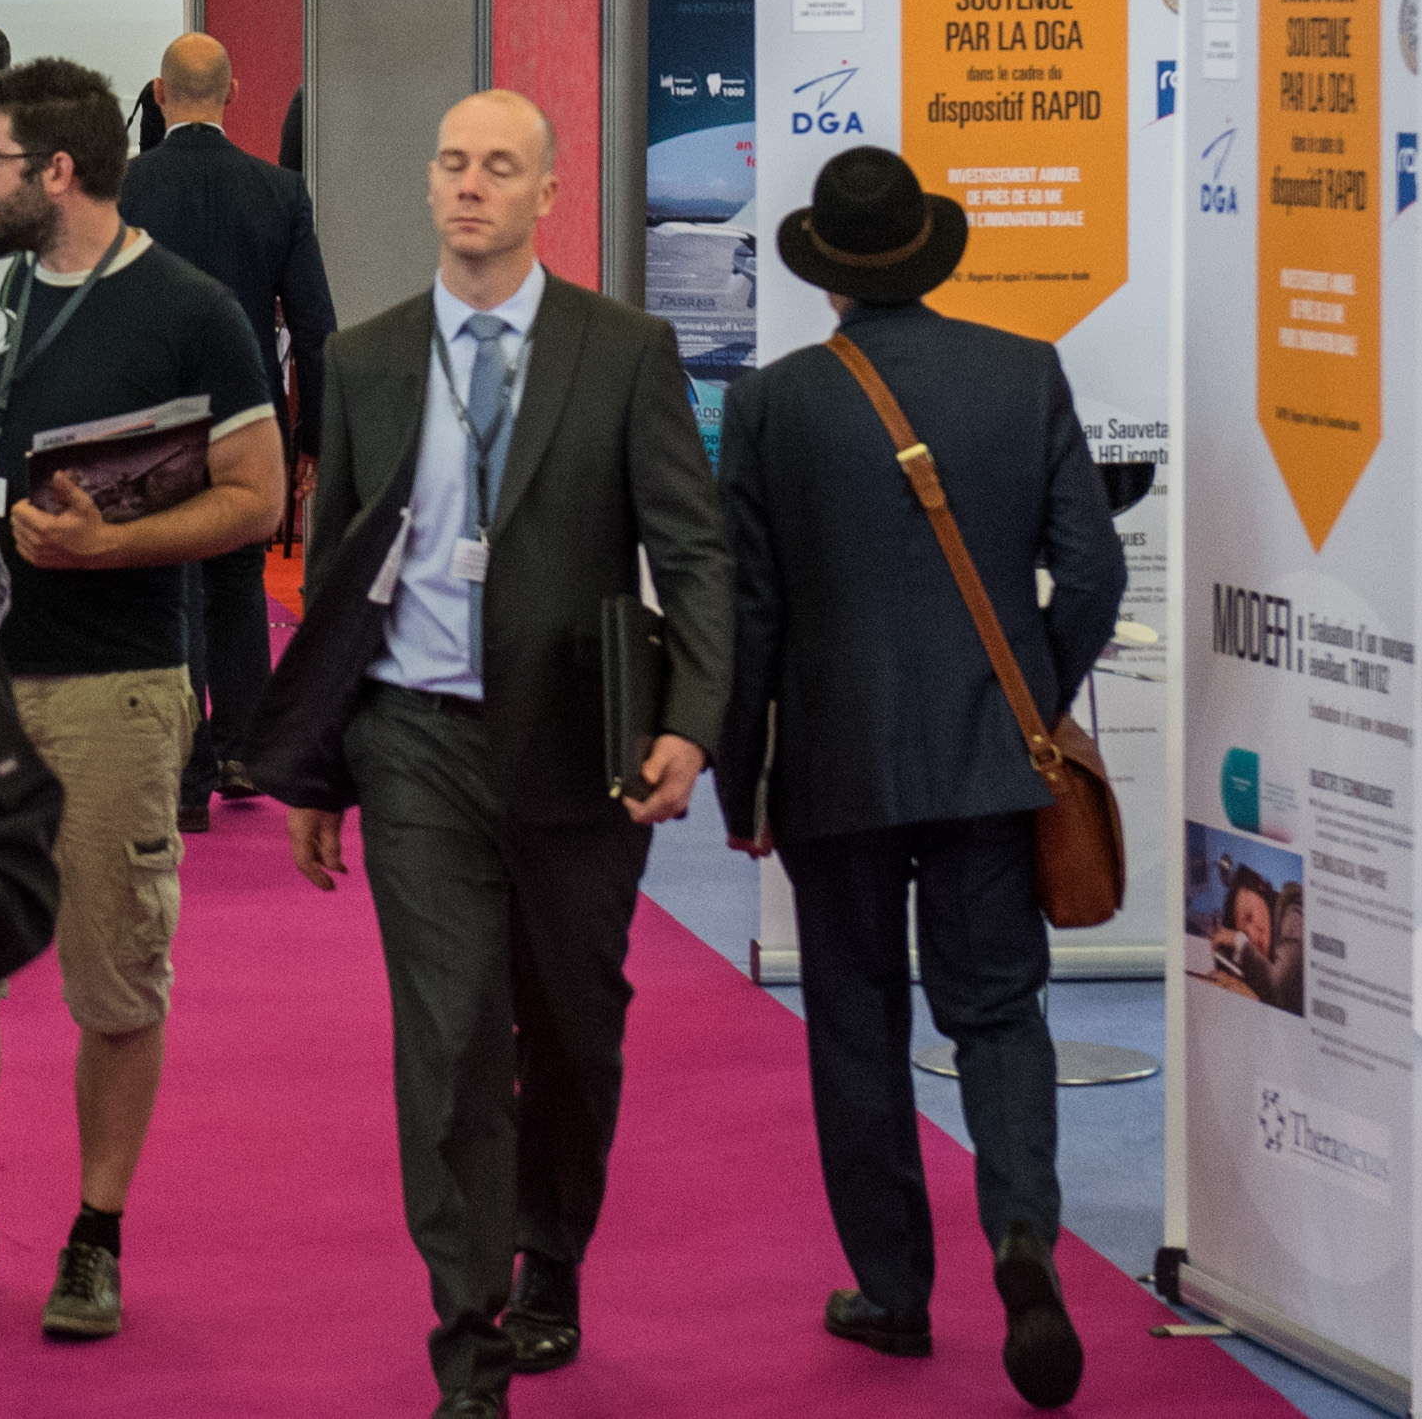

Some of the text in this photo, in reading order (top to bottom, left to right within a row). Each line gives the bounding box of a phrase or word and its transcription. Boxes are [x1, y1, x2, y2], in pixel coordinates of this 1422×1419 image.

[945, 20, 1083, 51] PAR LA DGA
[967, 65, 1062, 81] dans le cadre du
[722, 87, 745, 97] 1000
[927, 90, 1101, 128] dispositif RAPID
[792, 112, 863, 134] DGA
[736, 140, 753, 151] an
[1201, 183, 1238, 213] DGA
